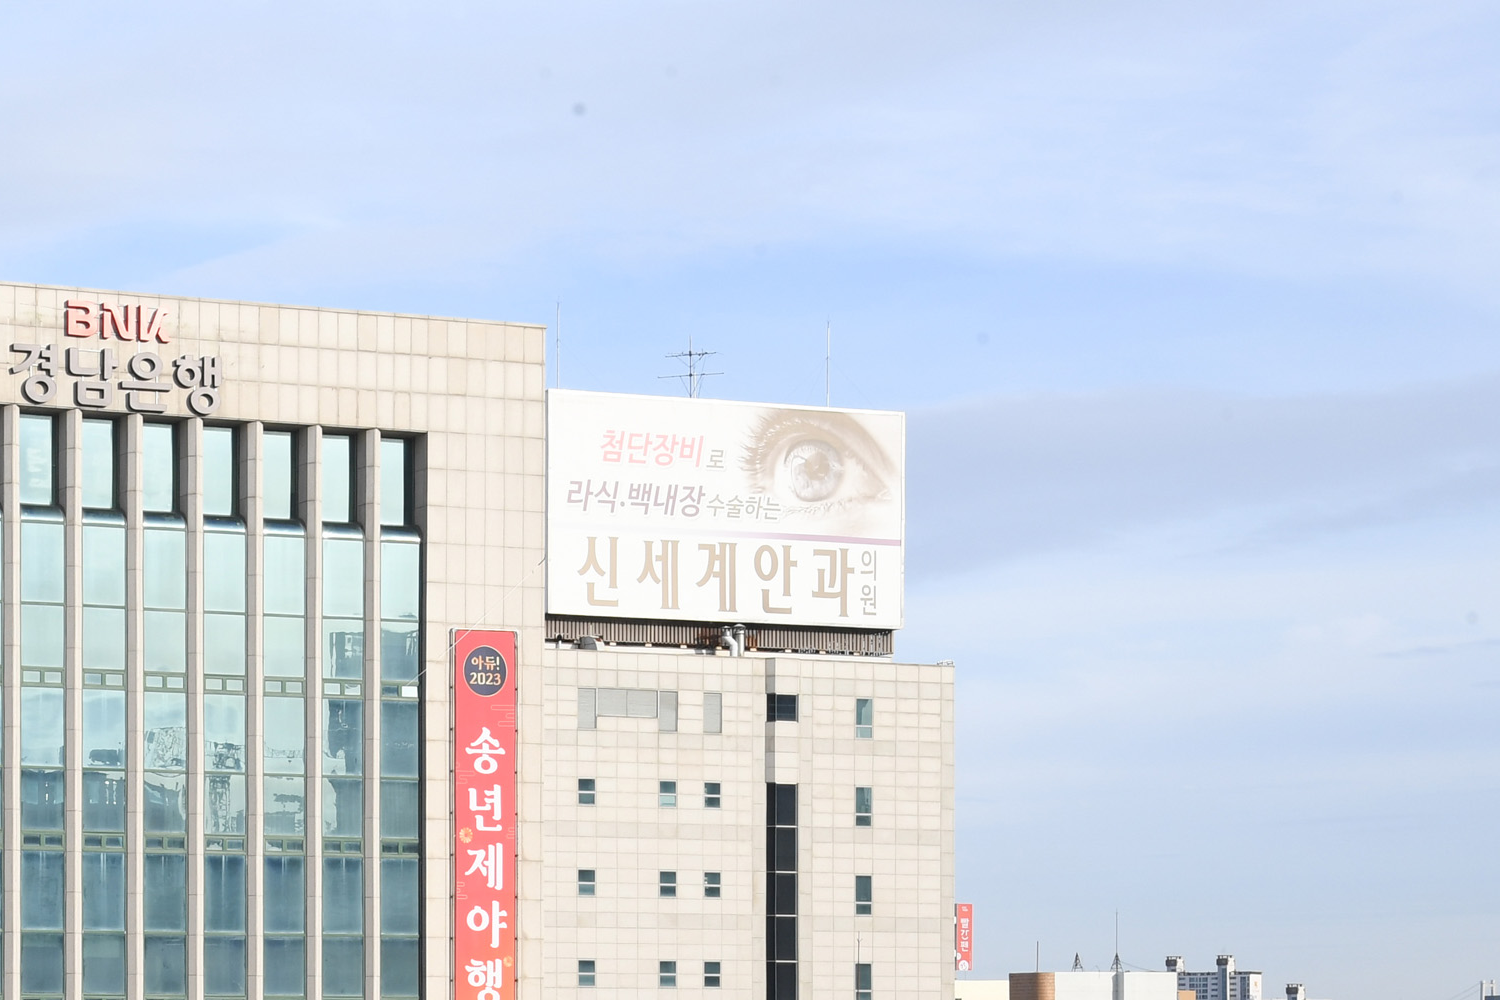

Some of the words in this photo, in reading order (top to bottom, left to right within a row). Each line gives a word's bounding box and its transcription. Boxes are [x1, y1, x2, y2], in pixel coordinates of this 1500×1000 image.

[64, 299, 171, 344] BNK
[8, 343, 222, 416] 경남은행
[706, 493, 782, 521] 수술하는
[577, 535, 855, 618] 신세계안과
[860, 550, 878, 617] 의원
[469, 671, 502, 686] 2023
[470, 655, 501, 671] 아듀!
